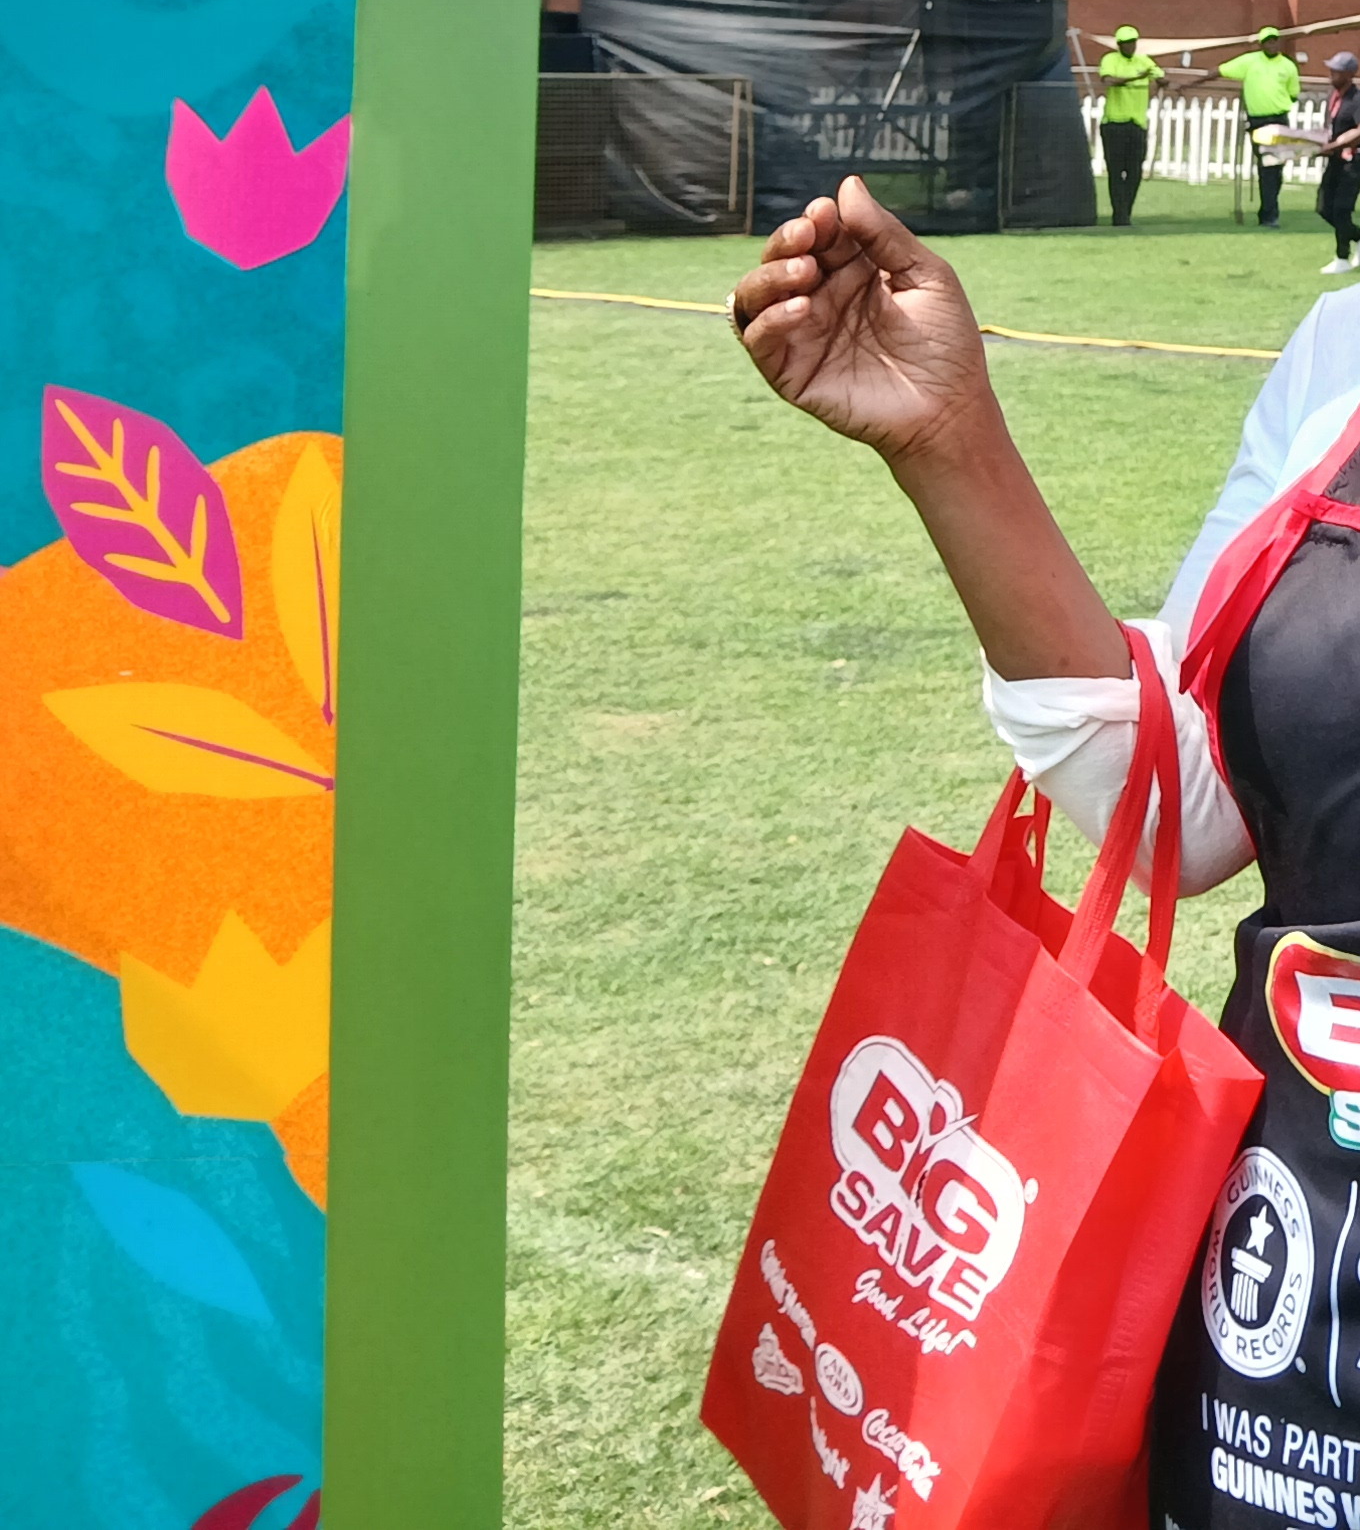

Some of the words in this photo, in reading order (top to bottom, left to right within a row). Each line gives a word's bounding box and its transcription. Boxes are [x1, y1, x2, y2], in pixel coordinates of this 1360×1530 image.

[1226, 1164, 1301, 1239] GUINNESS
[836, 1169, 988, 1311] SAVE
[851, 1268, 903, 1320] Good
[1208, 1229, 1230, 1339] WORLD
[1236, 1273, 1303, 1359] RECORDS
[1201, 1392, 1209, 1431] I
[1213, 1398, 1273, 1459] WAS
